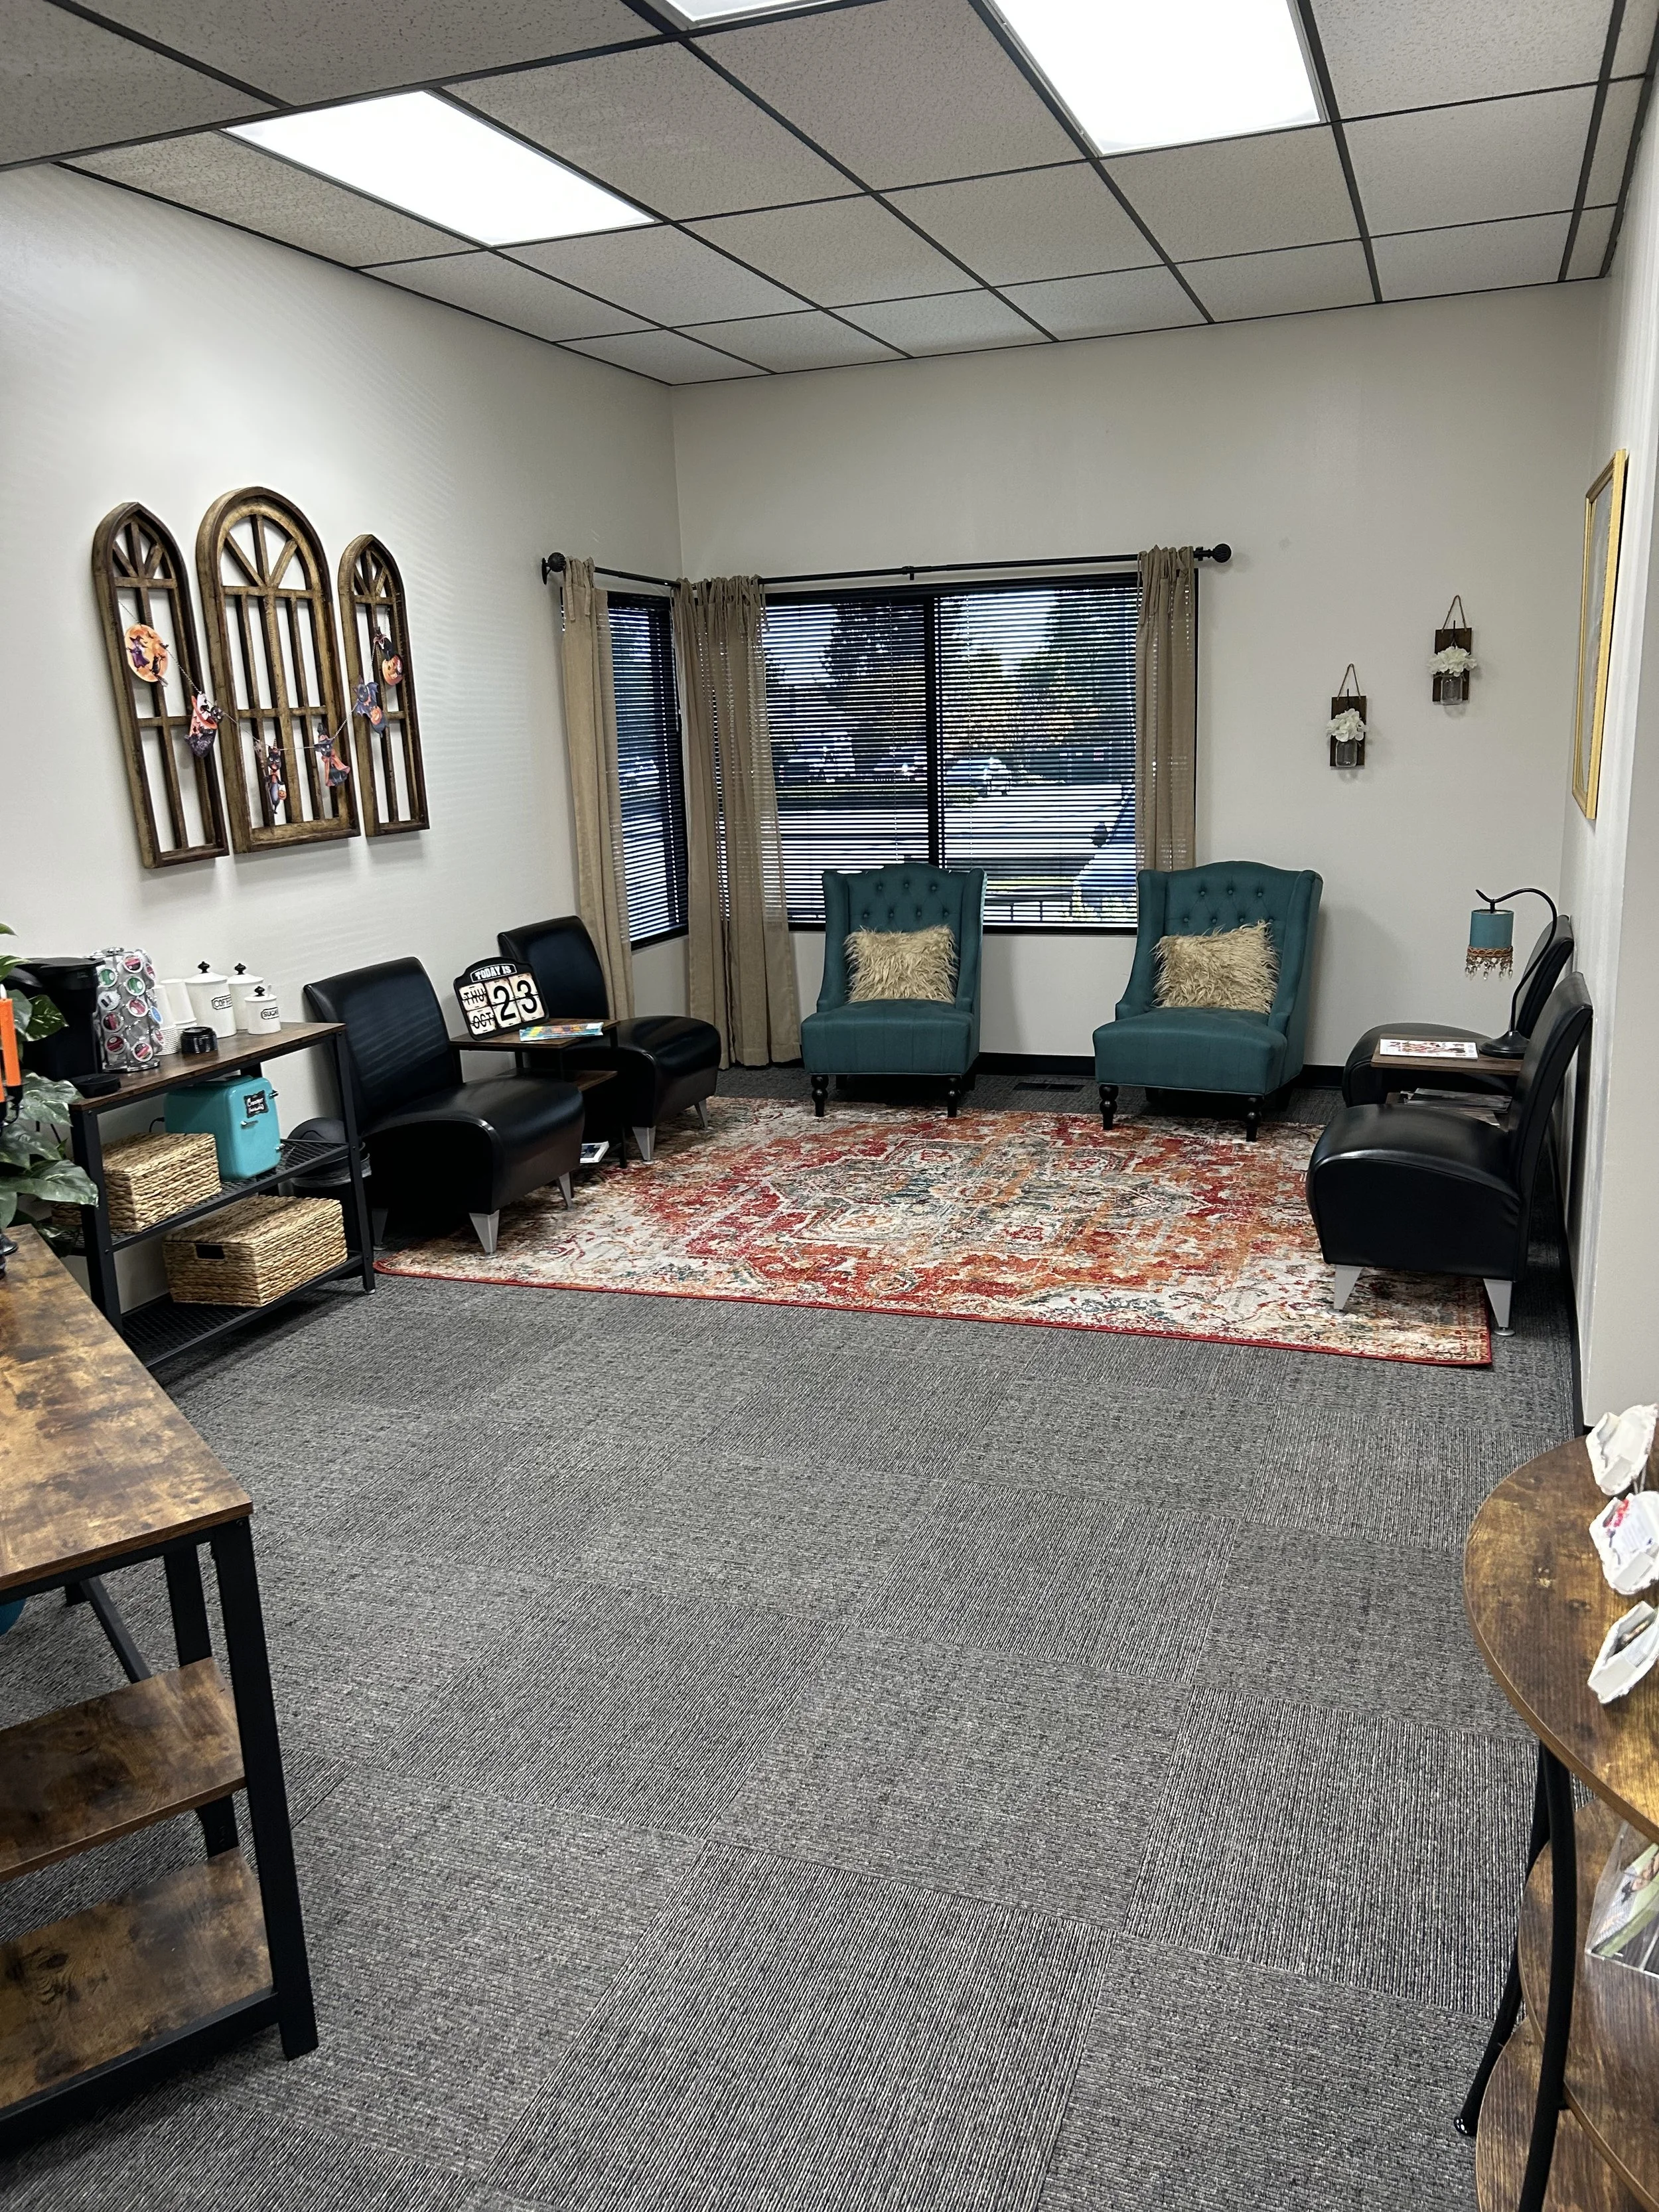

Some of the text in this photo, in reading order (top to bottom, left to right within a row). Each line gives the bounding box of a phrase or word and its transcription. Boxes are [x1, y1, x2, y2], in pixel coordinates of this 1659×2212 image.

[474, 965, 512, 980] TODAY IS
[463, 988, 485, 1005] THU
[472, 1012, 492, 1029] OCT
